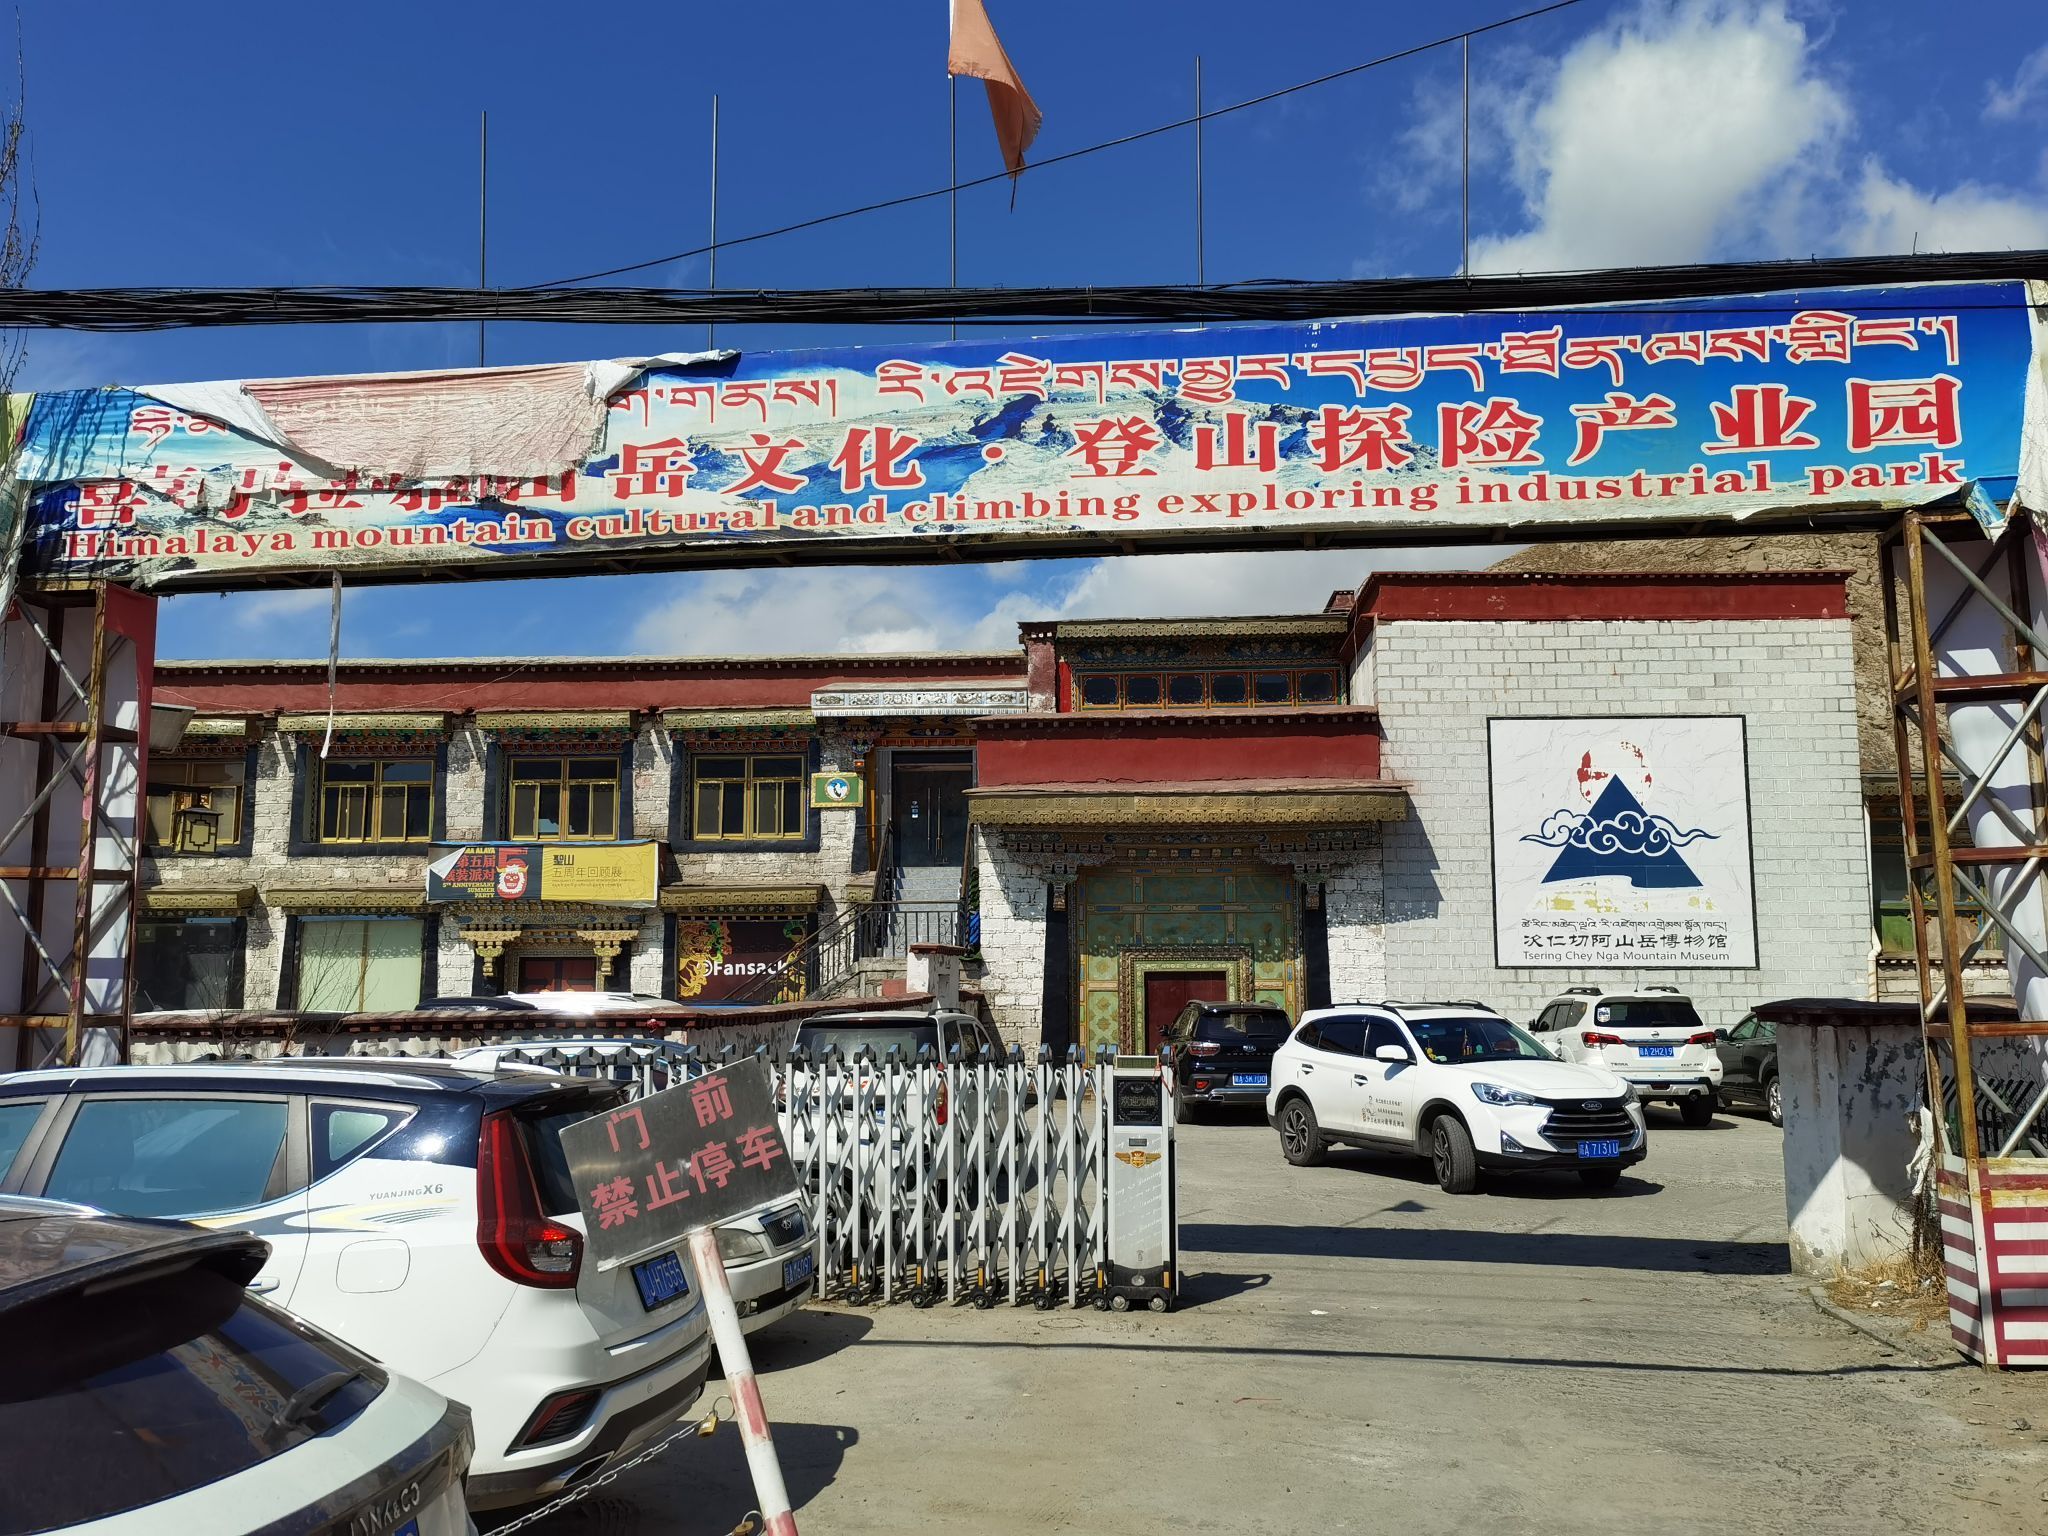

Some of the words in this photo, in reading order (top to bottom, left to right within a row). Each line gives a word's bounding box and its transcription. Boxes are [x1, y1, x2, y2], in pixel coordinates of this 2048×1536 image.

[64, 528, 296, 559] Himalaya
[311, 509, 551, 549] mountain
[567, 498, 776, 539] cultural
[792, 497, 897, 527] and
[903, 489, 1142, 521] climbing
[1157, 481, 1439, 518] exploring
[1456, 462, 1771, 505] industrial
[1808, 454, 1963, 497] park
[552, 866, 622, 878] 五周年回顾展
[1523, 933, 1728, 949] 次仁切阿山岳博物馆
[1523, 951, 1562, 962] Tsering
[1565, 951, 1593, 962] Chey
[1596, 951, 1619, 961] Nga
[1623, 951, 1677, 961] Mountain
[1681, 951, 1730, 961] Museum
[590, 1124, 783, 1230] 禁止停车
